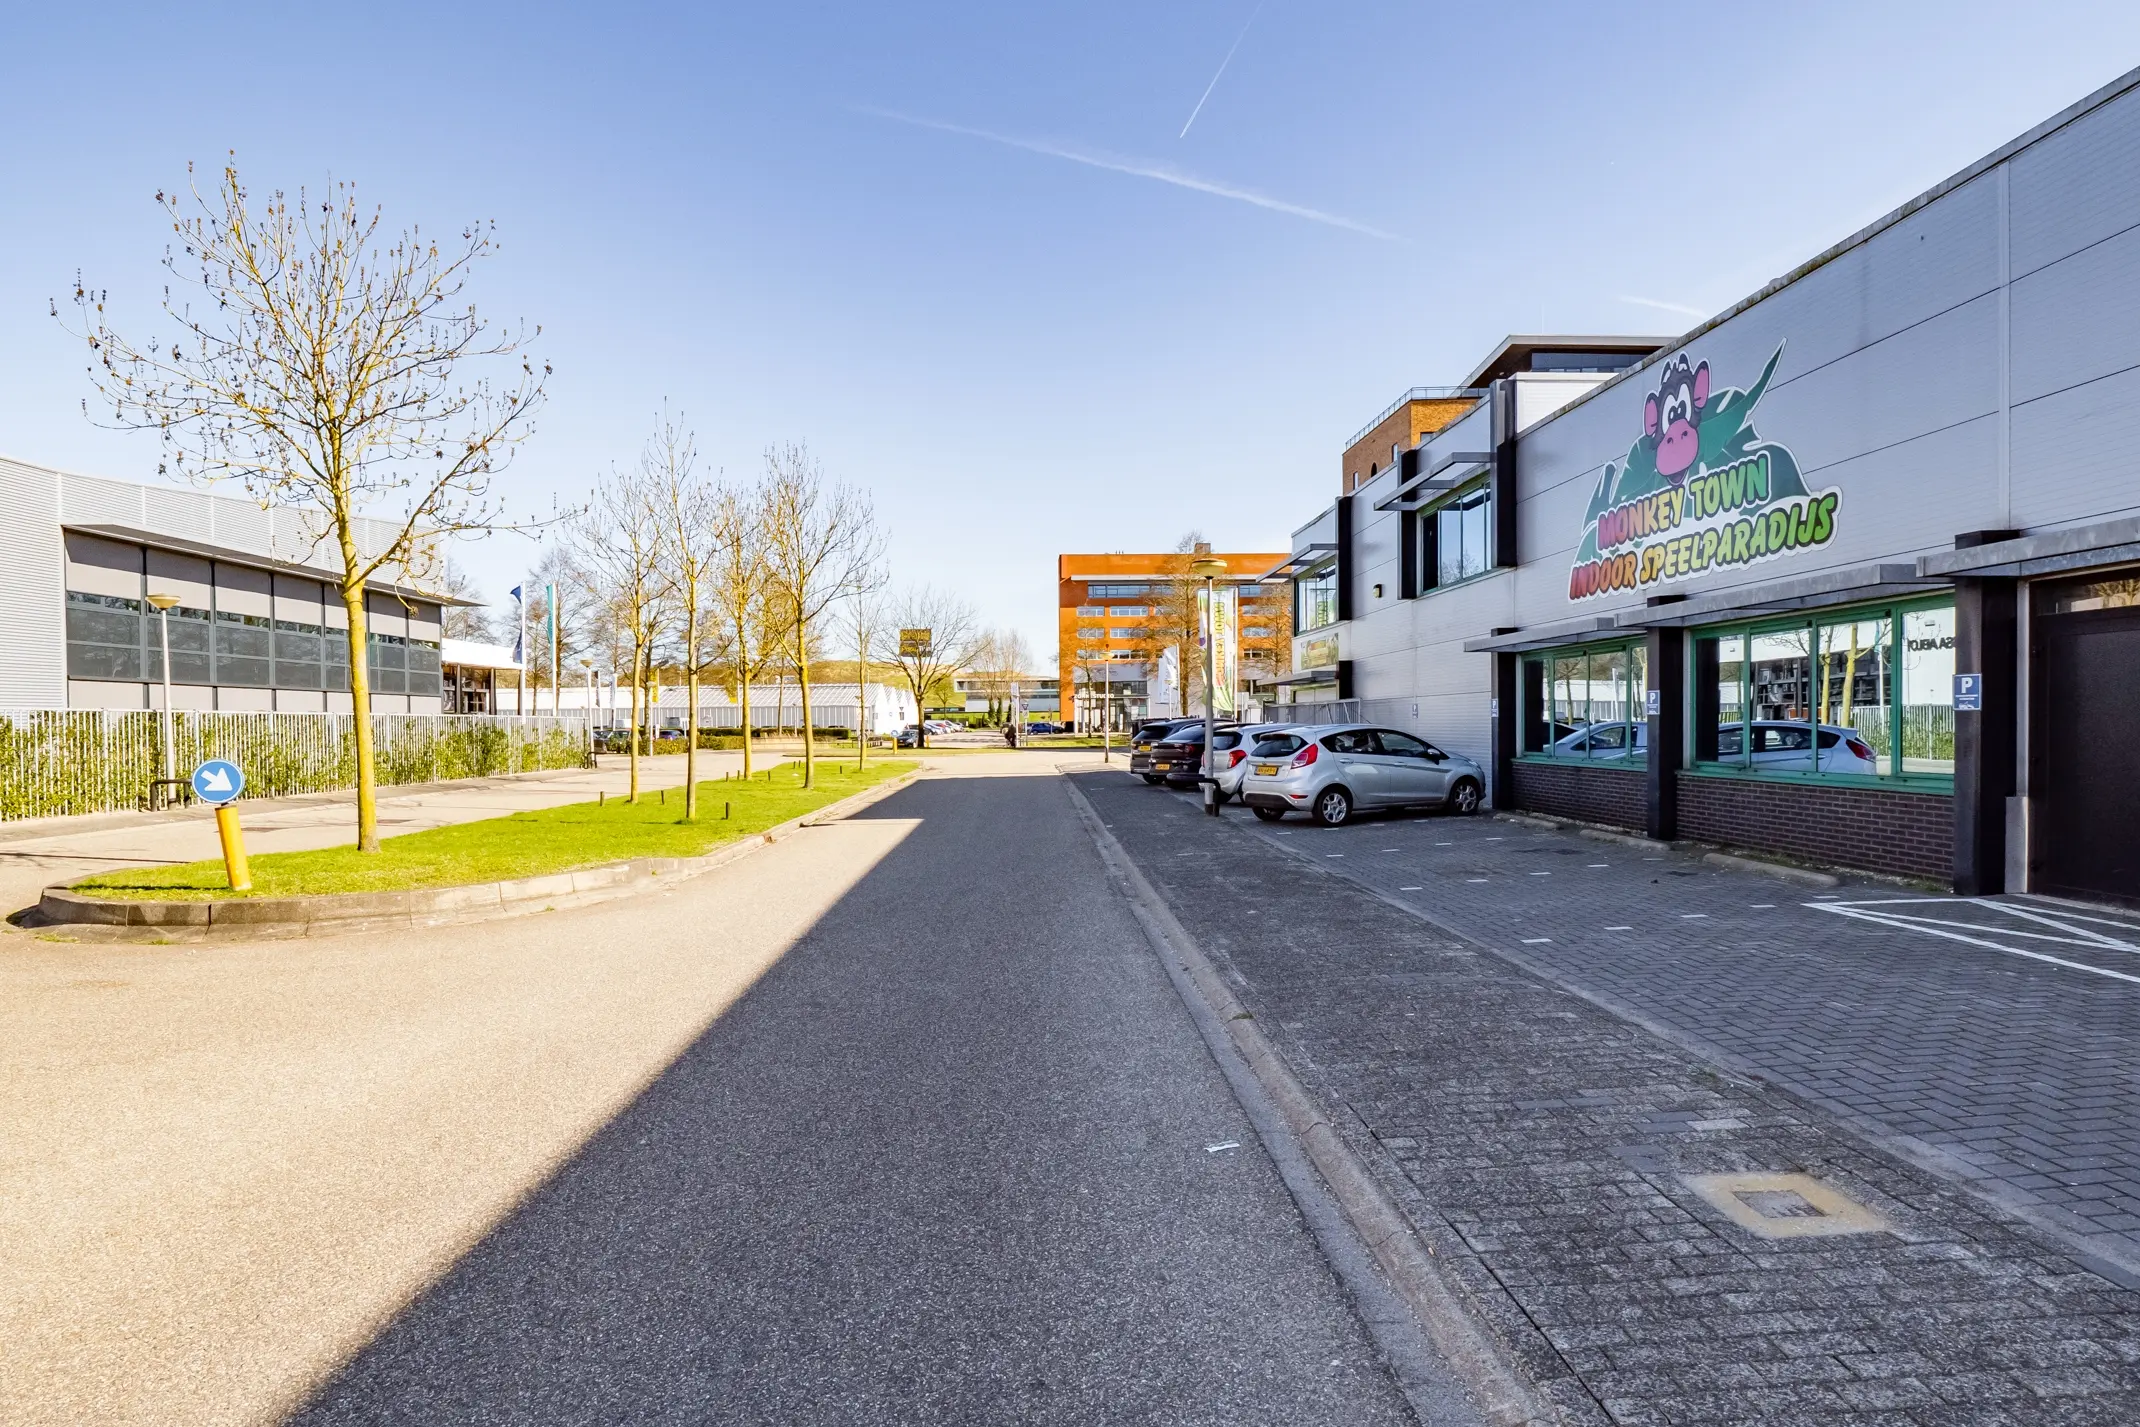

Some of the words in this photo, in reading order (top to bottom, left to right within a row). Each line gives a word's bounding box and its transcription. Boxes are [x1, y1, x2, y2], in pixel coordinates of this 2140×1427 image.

[1598, 486, 1685, 551] MONKEY
[1690, 453, 1769, 520] TOWN
[1568, 551, 1637, 600] INDOOR
[1640, 491, 1839, 583] SPEELPARADIJS
[1650, 692, 1656, 704] P
[1961, 677, 1973, 693] P
